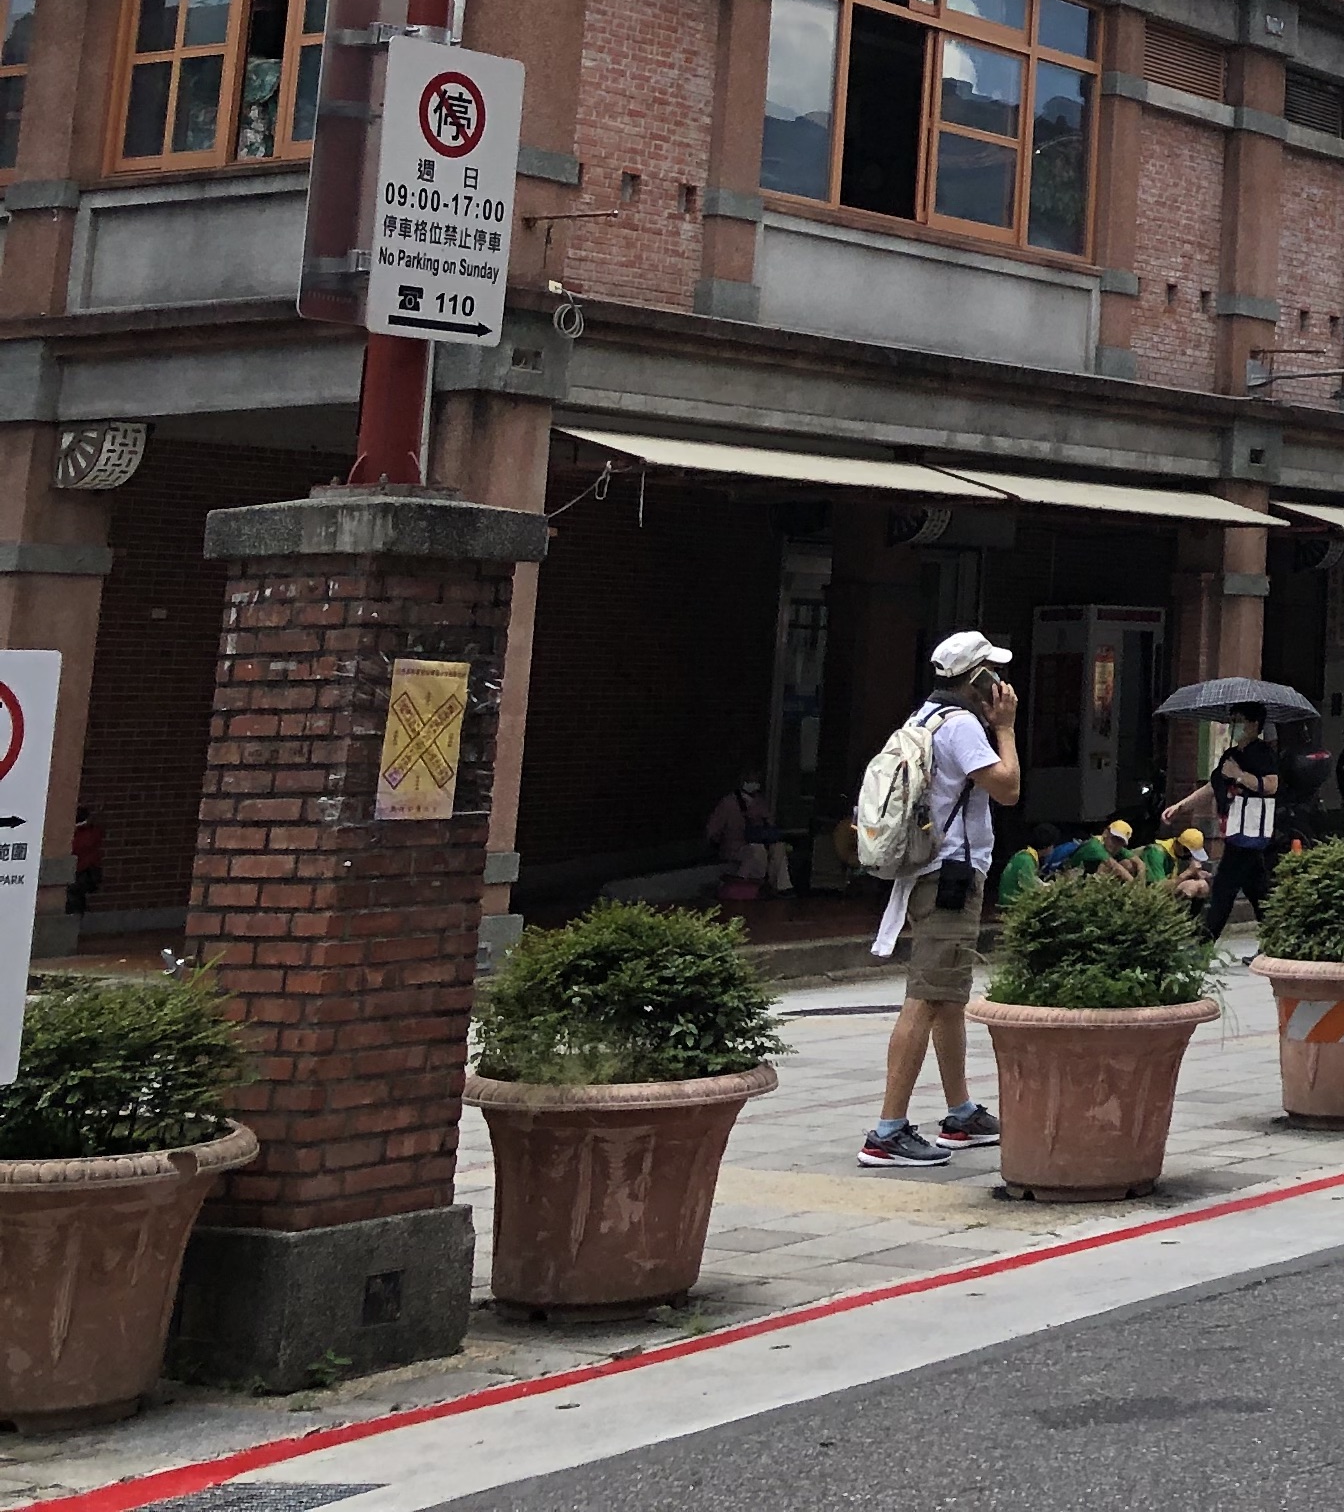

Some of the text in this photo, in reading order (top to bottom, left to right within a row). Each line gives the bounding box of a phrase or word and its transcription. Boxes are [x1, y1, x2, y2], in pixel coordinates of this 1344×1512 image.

[385, 181, 505, 223] 09:00-17:00
[383, 213, 502, 254] 停車格位禁止停車
[378, 245, 500, 285] No Parking on Sunday
[435, 291, 475, 318] 110
